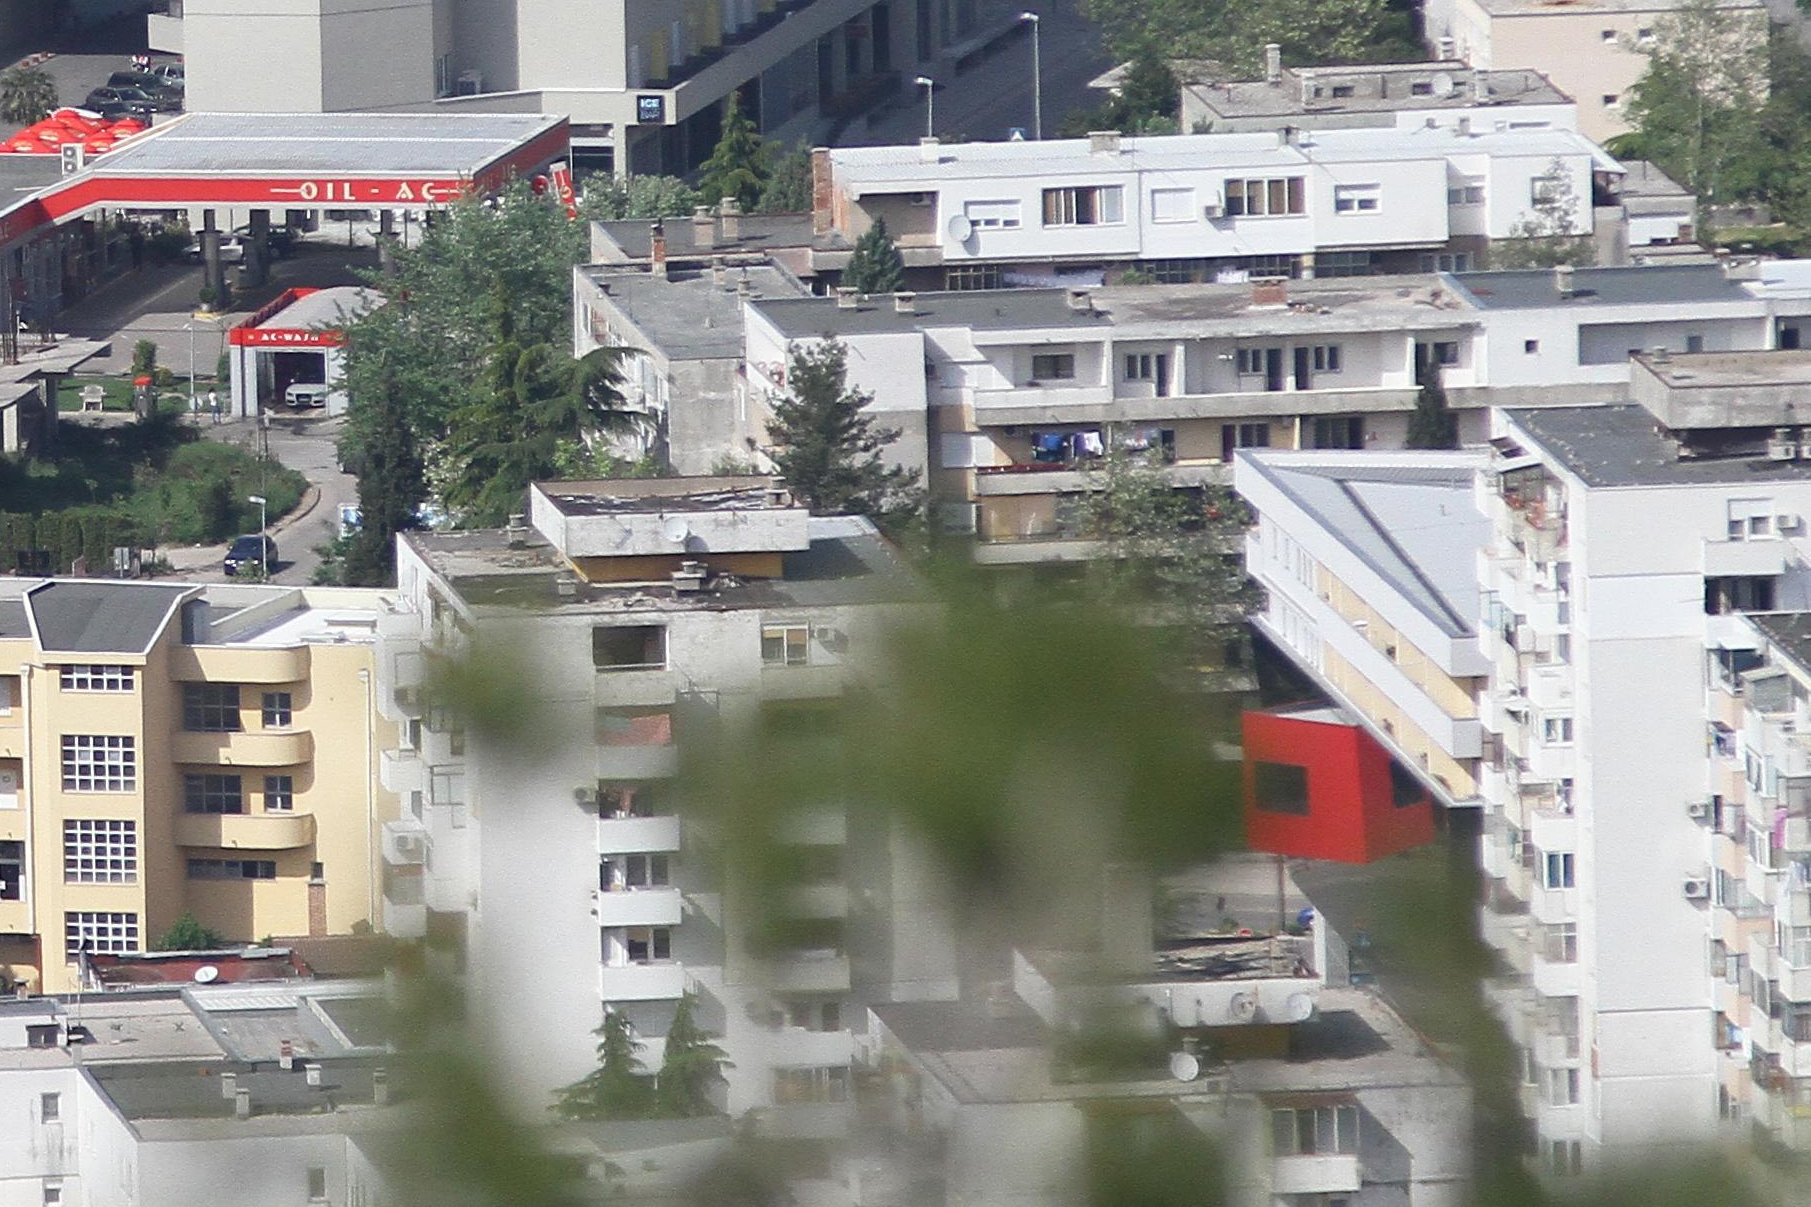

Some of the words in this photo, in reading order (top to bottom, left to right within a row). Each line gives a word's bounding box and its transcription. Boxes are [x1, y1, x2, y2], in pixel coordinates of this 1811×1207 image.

[640, 98, 660, 108] ICE
[300, 181, 356, 201] OIL
[395, 181, 437, 201] AC
